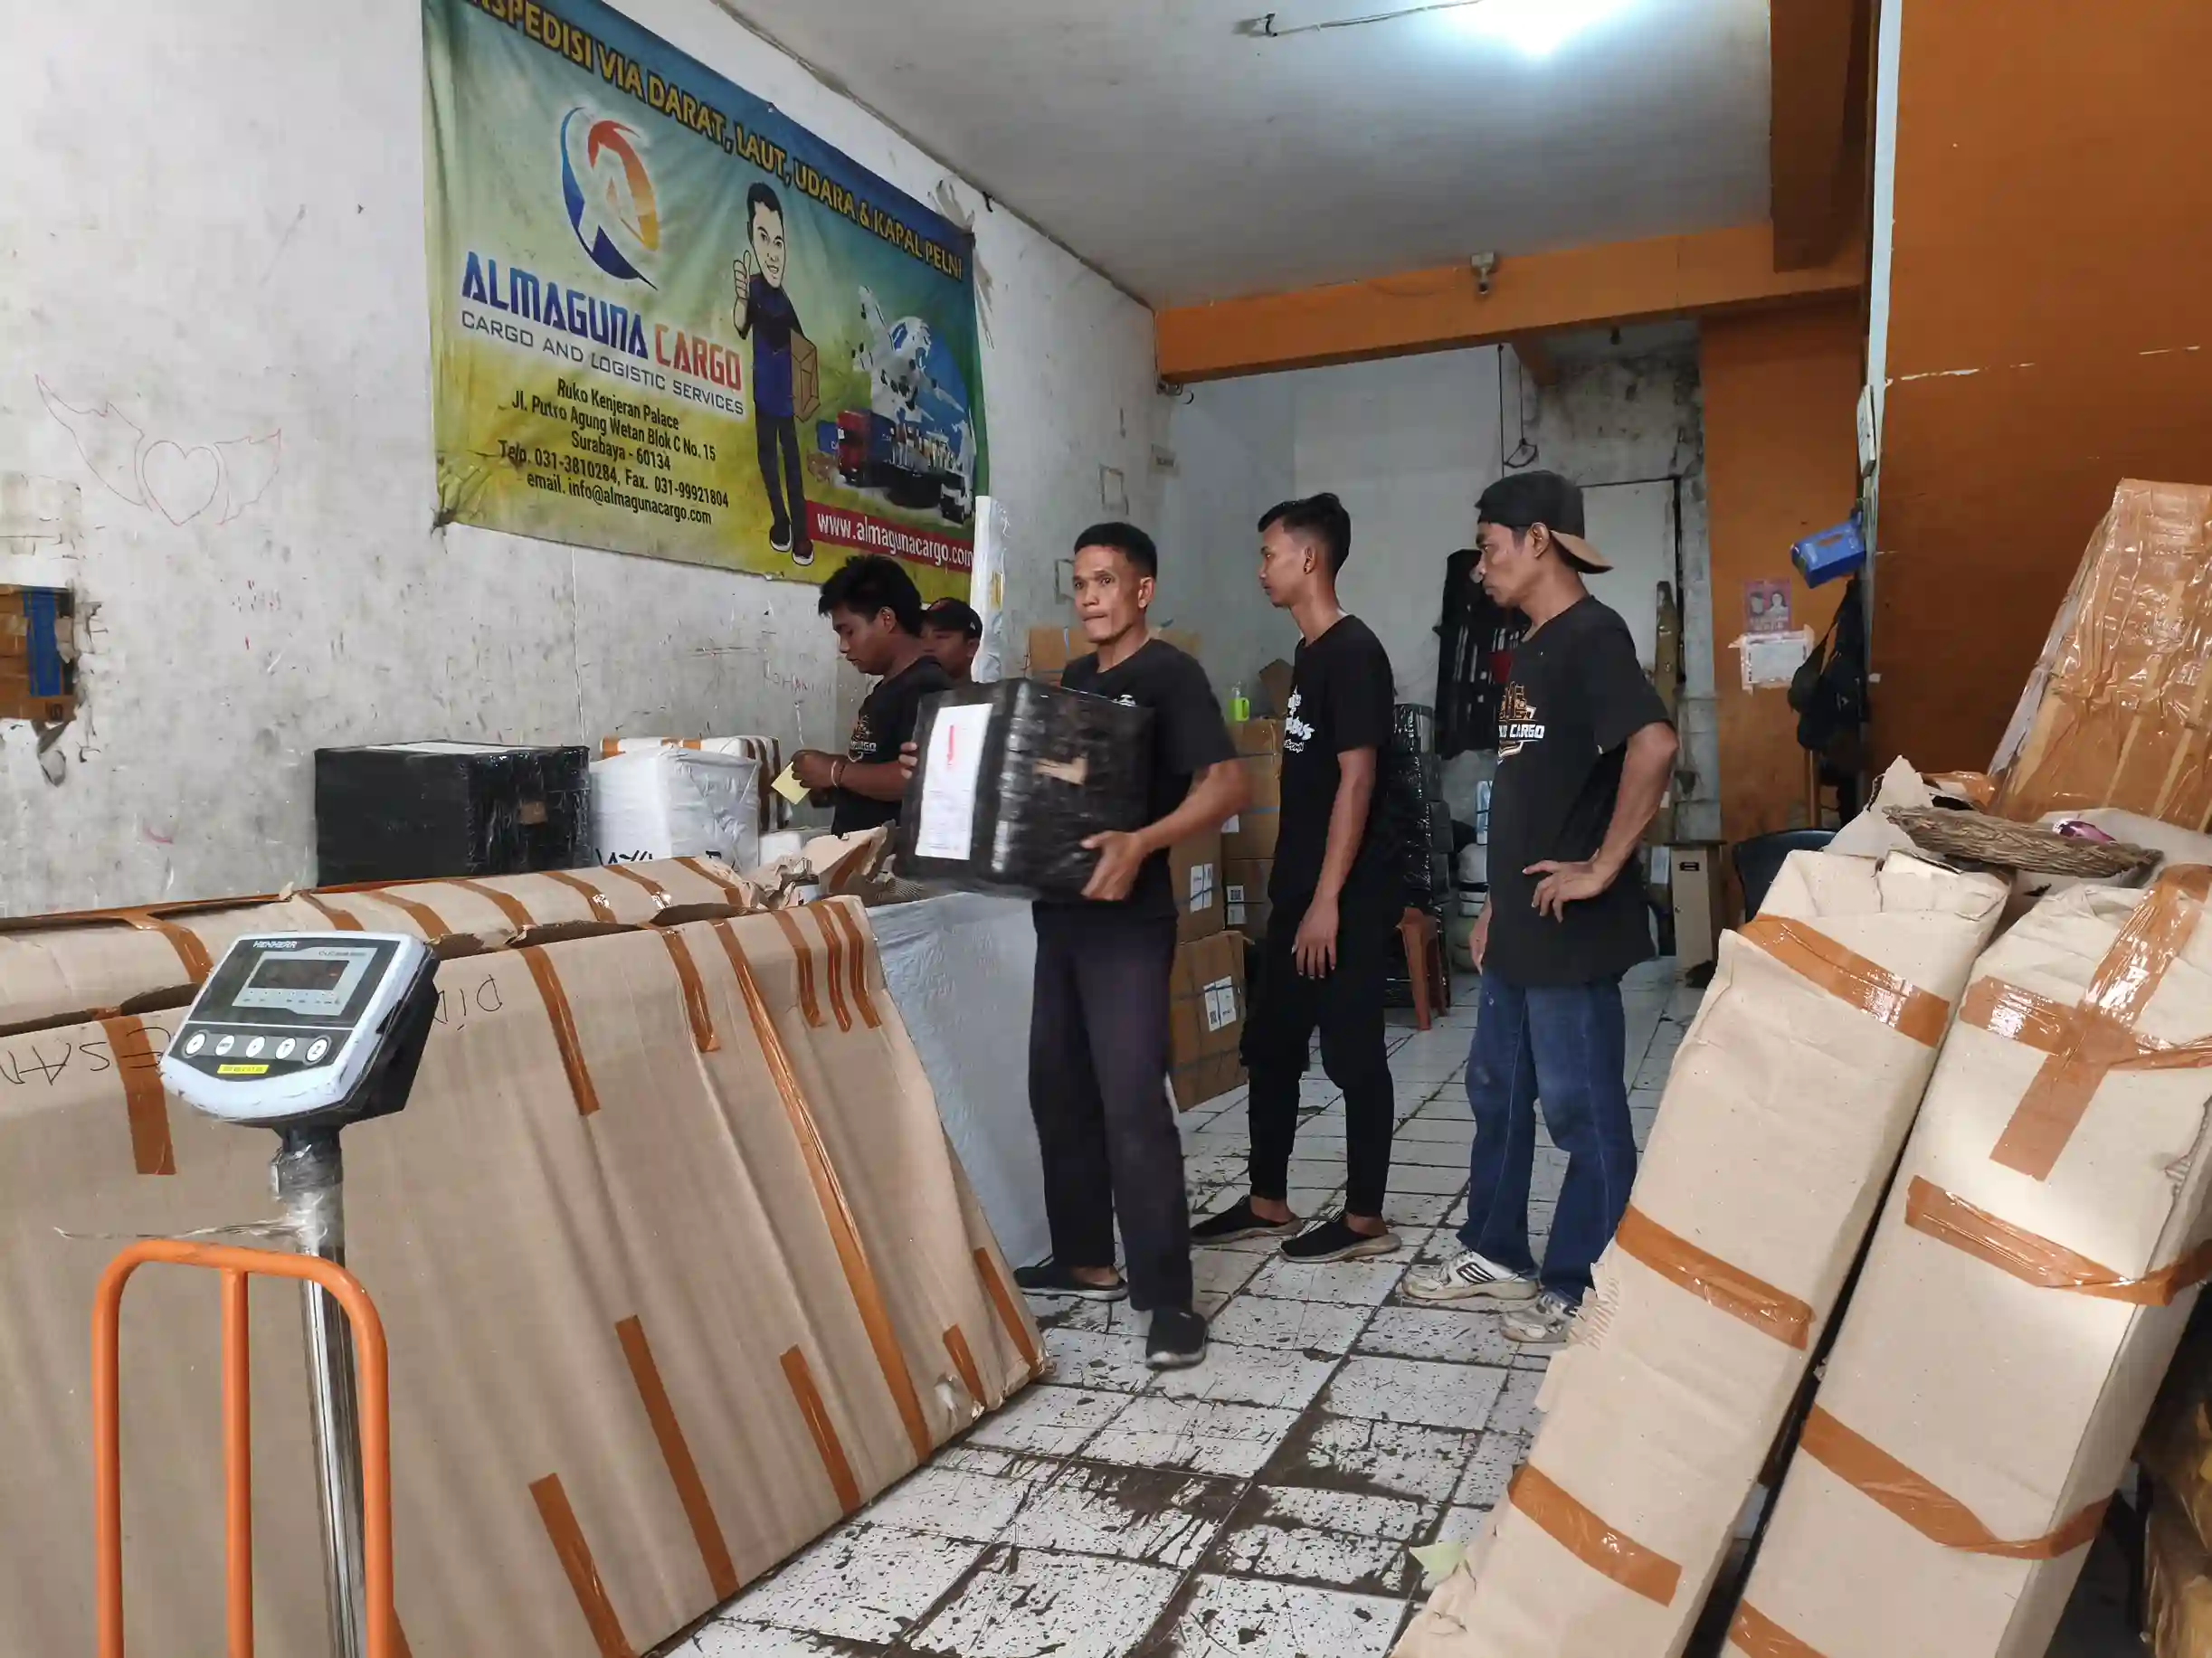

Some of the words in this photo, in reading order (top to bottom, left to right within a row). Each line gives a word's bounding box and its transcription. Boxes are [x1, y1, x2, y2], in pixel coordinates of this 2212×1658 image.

[472, 0, 593, 71] SPEDISI
[597, 44, 644, 99] VIA
[647, 71, 733, 153] DARAT,
[736, 123, 793, 185] LAUT,
[794, 159, 858, 220] UDARA
[859, 201, 871, 228] &
[873, 209, 923, 259] KAPAL
[924, 240, 964, 280] PELNI
[461, 251, 649, 360] ALMAGUNA
[654, 323, 742, 392] CARGO
[461, 310, 534, 347] CARGO
[543, 336, 584, 363] AND
[591, 352, 666, 390] LOGISTIC
[672, 380, 744, 415] SERVICES
[531, 394, 567, 421] Putro
[570, 406, 607, 436] Agung
[609, 419, 645, 442] Wetan
[647, 427, 671, 450] Blok
[673, 437, 681, 451] C
[683, 437, 701, 459] No.
[703, 443, 717, 461] 15
[557, 377, 588, 403] Ruko
[591, 388, 641, 419] Kenjeran
[643, 407, 679, 431] Palace
[571, 431, 626, 462] Surabaya
[636, 448, 671, 470] 60134
[527, 470, 565, 495] email.
[567, 476, 712, 526] info@almagunacargo.com
[625, 469, 649, 490] Fax.
[654, 479, 729, 508] 031-99921804
[1509, 724, 1545, 739] CARGO
